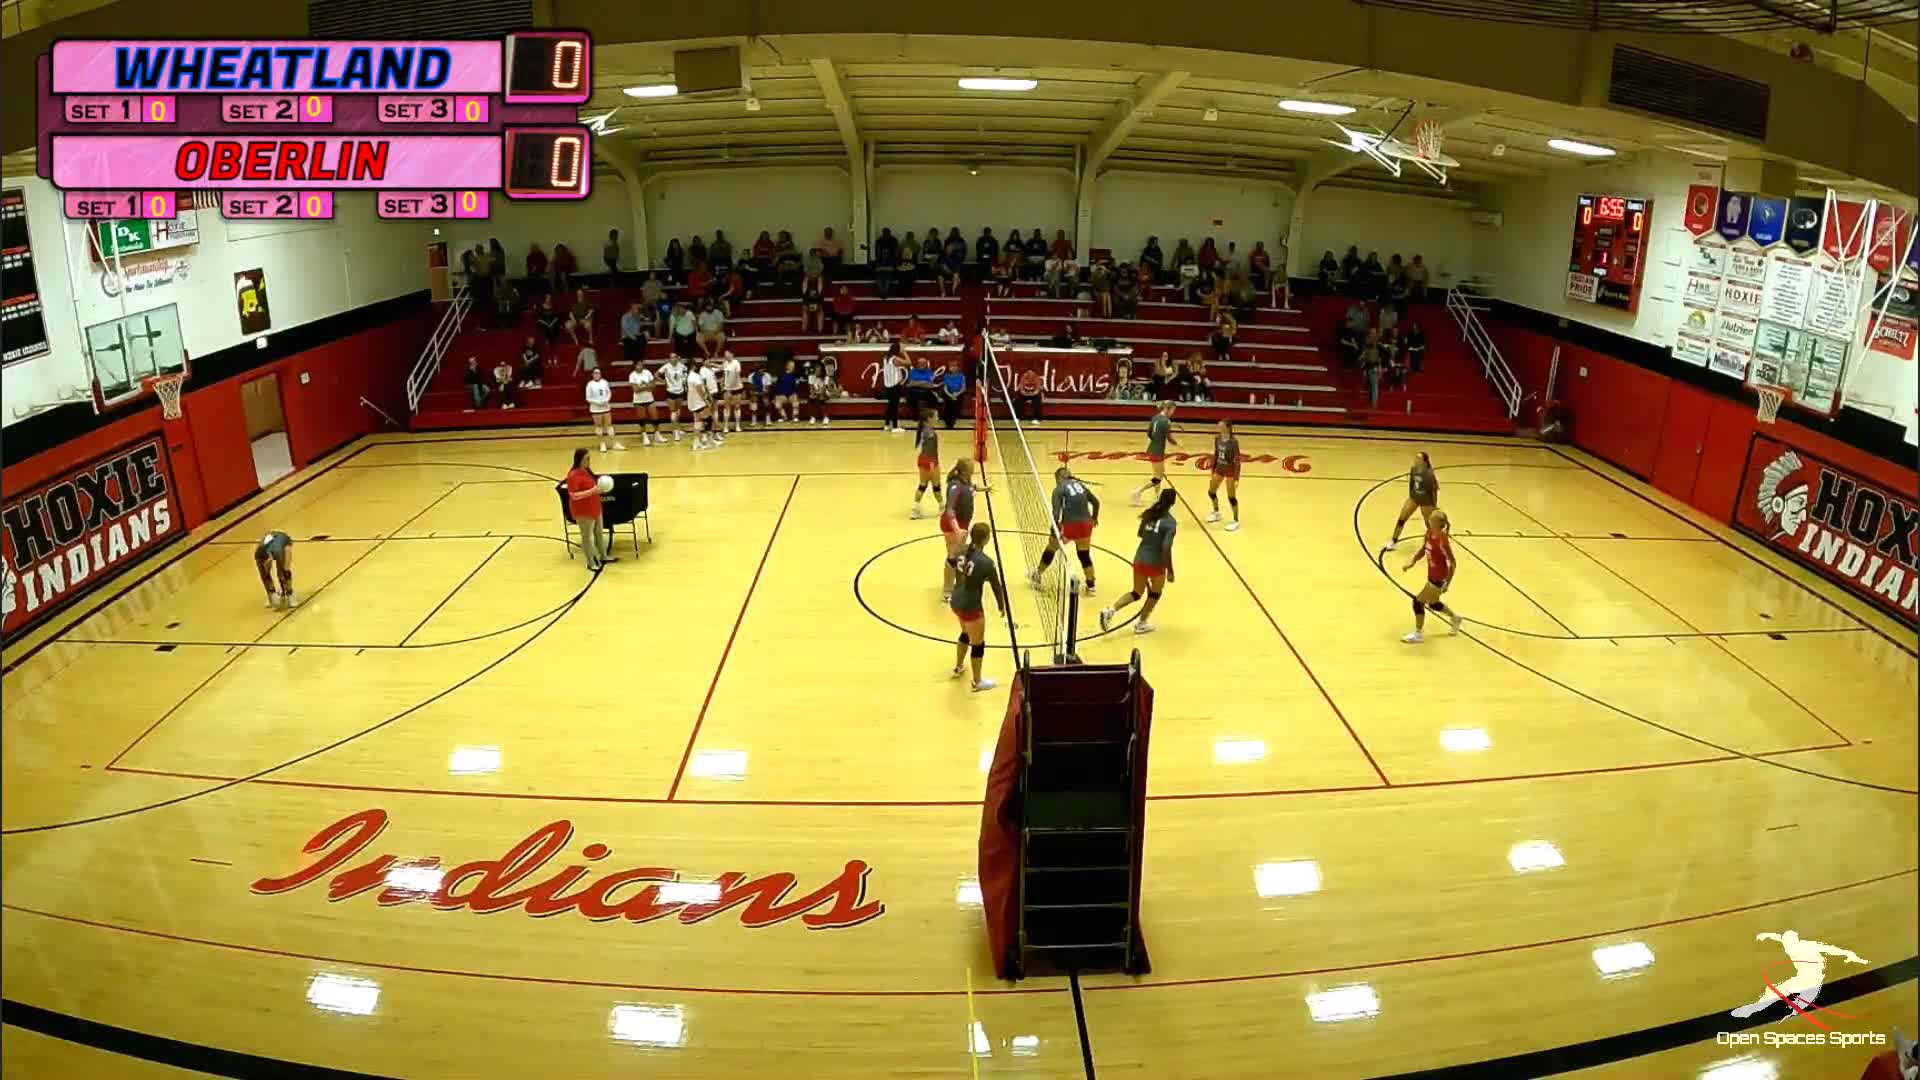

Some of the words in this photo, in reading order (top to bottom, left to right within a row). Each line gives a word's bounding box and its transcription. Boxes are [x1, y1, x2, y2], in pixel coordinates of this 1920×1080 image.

[1583, 206, 1592, 225] 0
[1633, 211, 1643, 231] 0
[2, 441, 168, 571] HOXIE
[21, 498, 171, 612] INDIANS
[1810, 467, 1919, 571] HOX
[250, 809, 885, 930] Indians
